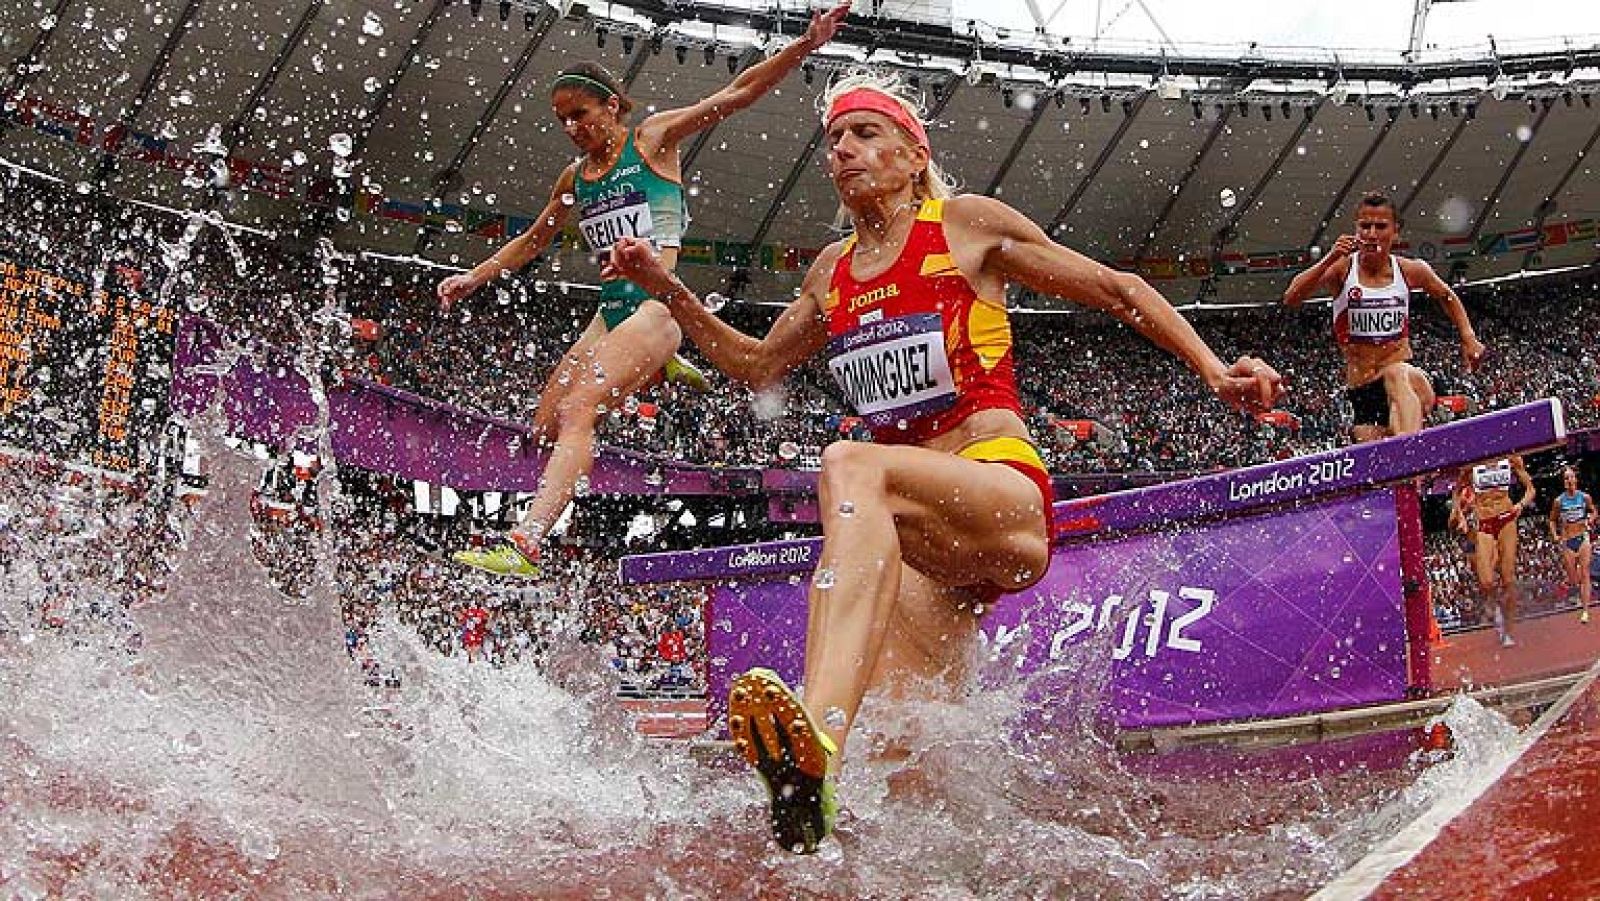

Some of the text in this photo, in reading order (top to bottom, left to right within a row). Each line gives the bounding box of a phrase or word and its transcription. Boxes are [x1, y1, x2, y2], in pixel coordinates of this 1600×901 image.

[876, 320, 906, 337] 2012
[1229, 457, 1355, 502] London 2012
[728, 546, 812, 568] London 2012
[1049, 585, 1216, 660] 2012
